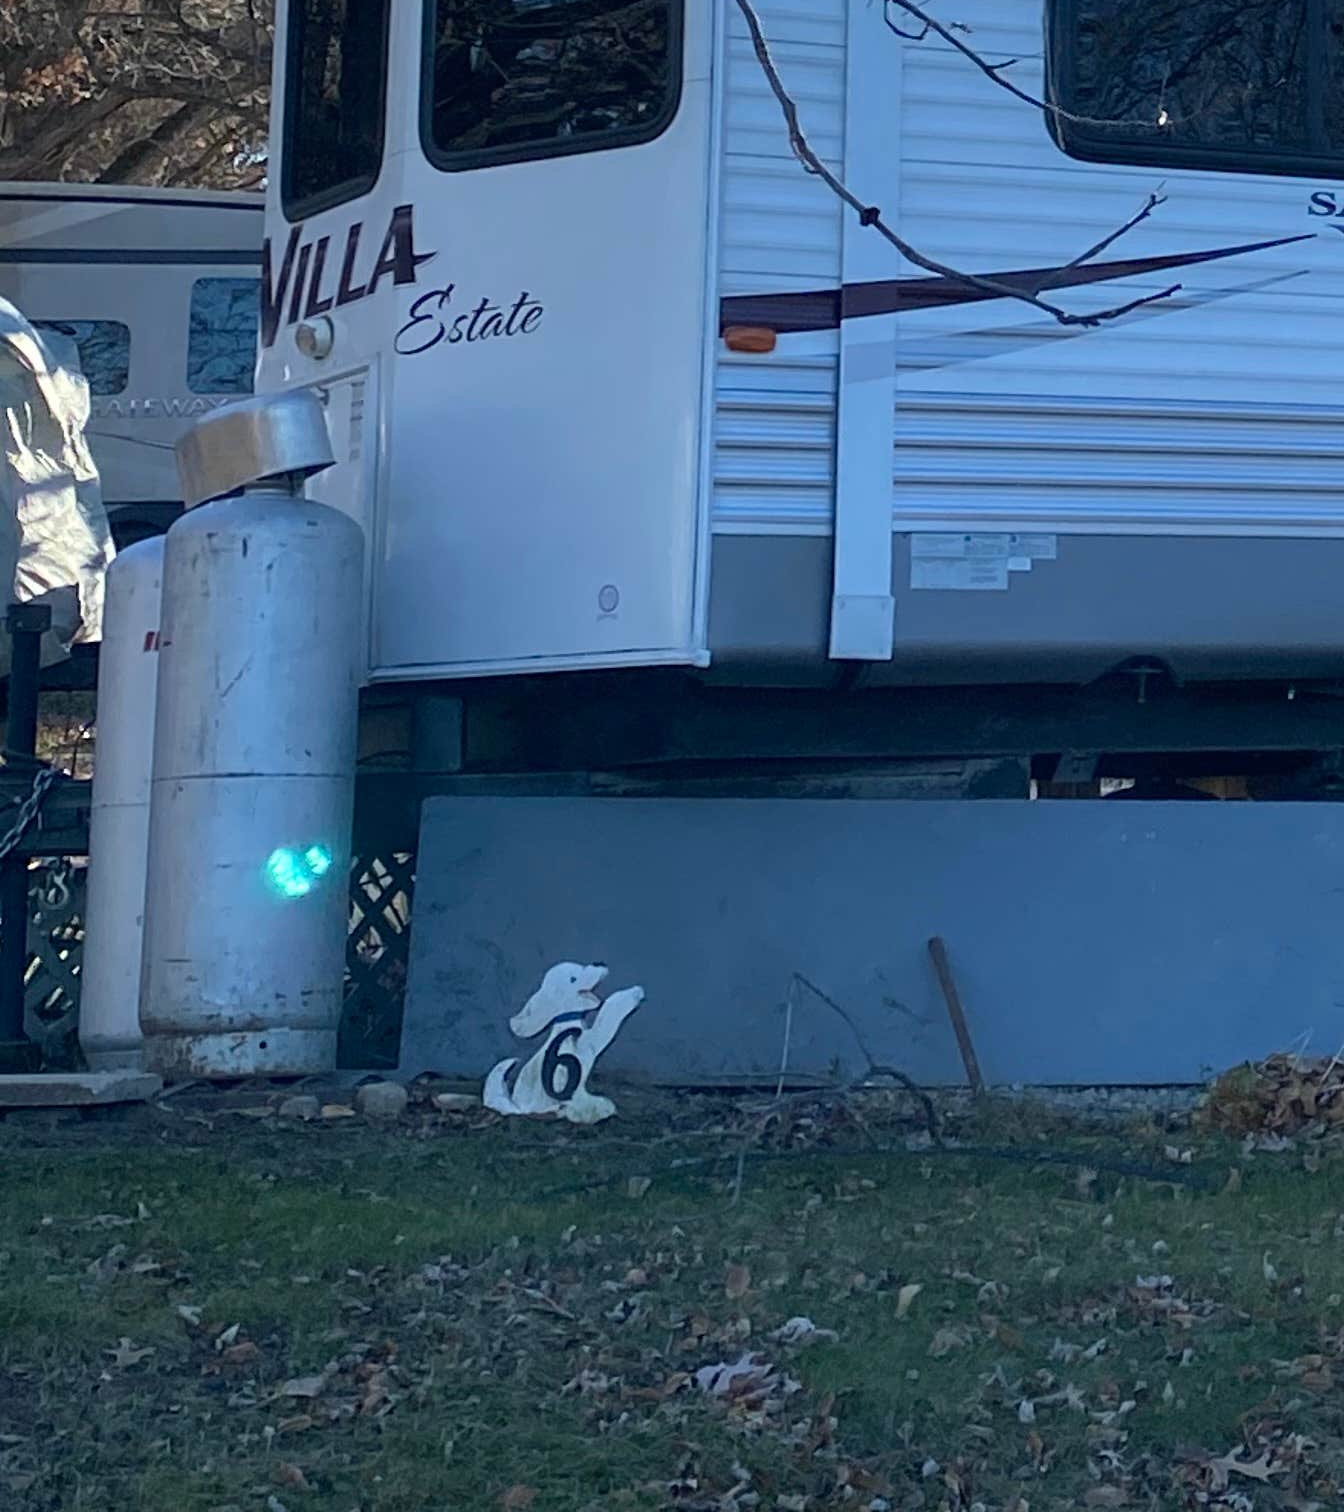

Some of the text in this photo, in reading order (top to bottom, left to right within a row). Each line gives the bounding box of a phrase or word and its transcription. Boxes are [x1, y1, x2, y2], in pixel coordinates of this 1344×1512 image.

[261, 204, 439, 349] VILLA
[394, 284, 544, 355] Estate
[541, 1027, 582, 1101] 6
